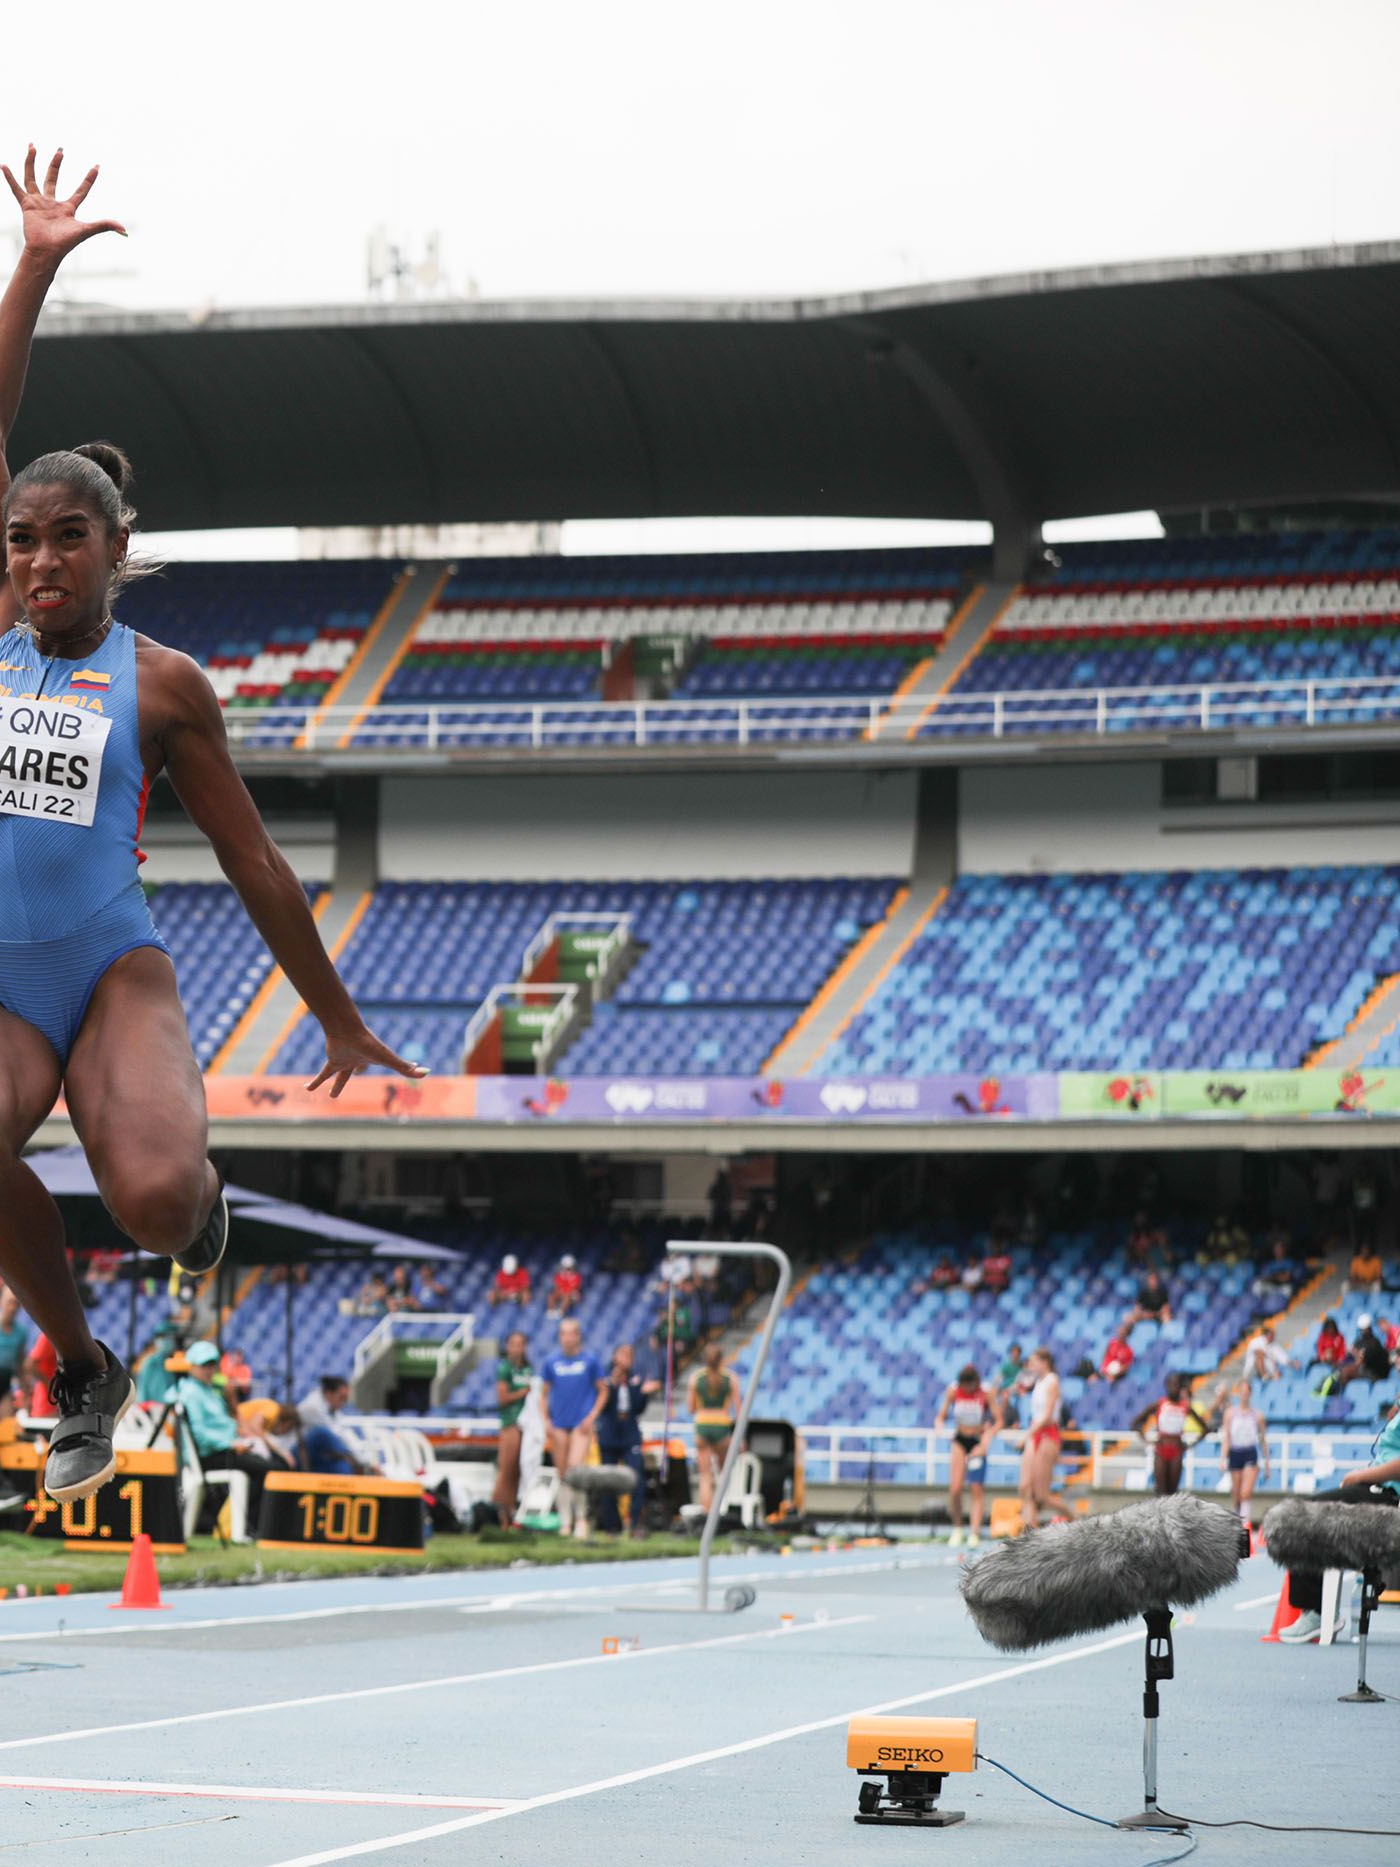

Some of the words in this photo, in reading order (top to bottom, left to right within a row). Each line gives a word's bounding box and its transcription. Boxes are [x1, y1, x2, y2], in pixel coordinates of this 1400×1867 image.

[9, 707, 82, 740] QNB
[43, 795, 75, 817] 22
[24, 1479, 143, 1538] +0.1
[298, 1494, 379, 1542] 1:00
[878, 1747, 944, 1762] SEIKO
